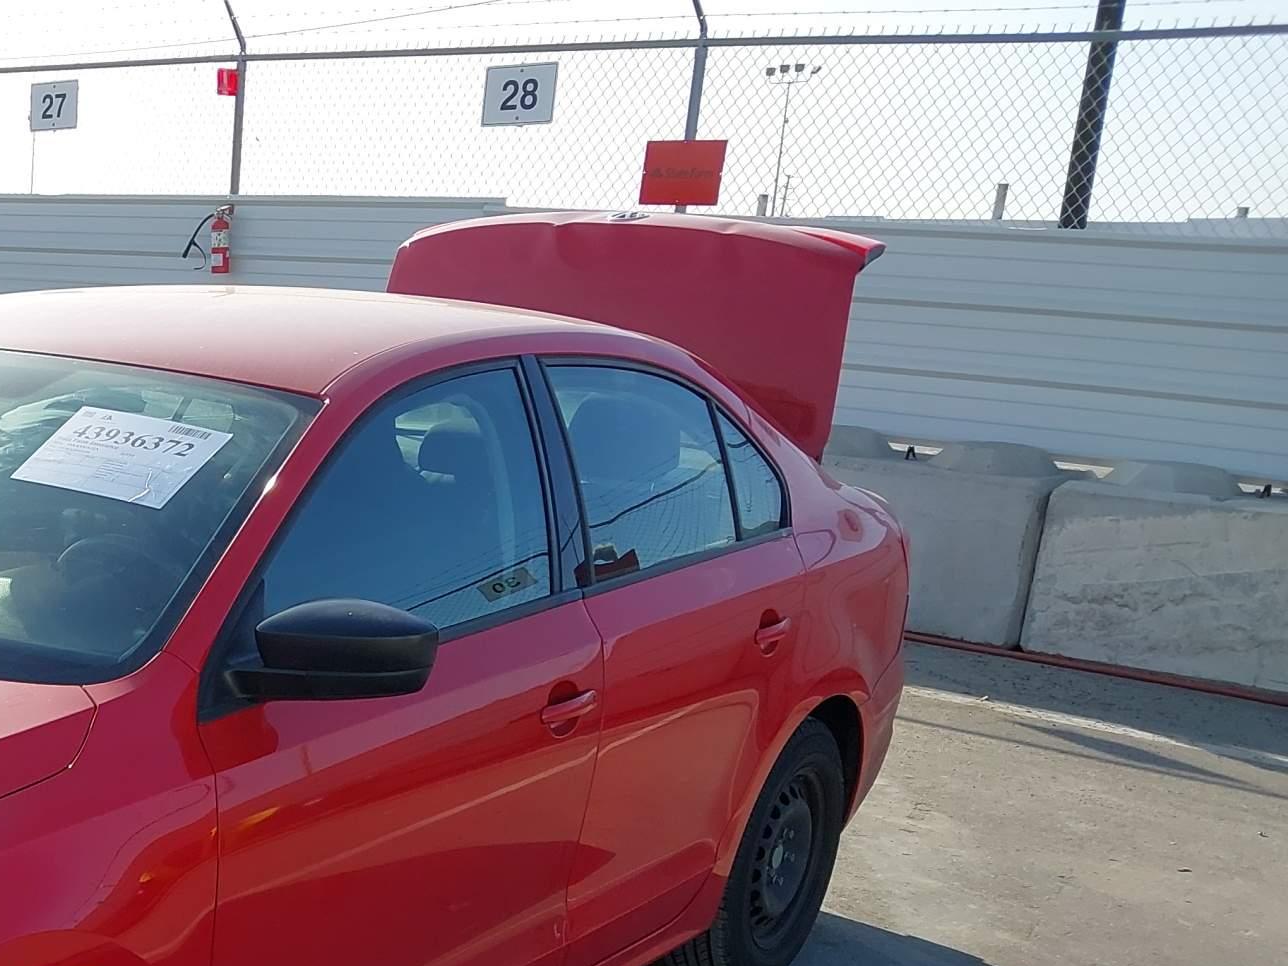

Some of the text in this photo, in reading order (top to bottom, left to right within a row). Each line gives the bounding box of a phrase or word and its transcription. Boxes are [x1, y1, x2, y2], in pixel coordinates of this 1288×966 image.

[41, 93, 67, 120] 27
[500, 78, 538, 111] 28
[72, 424, 196, 458] 43936372
